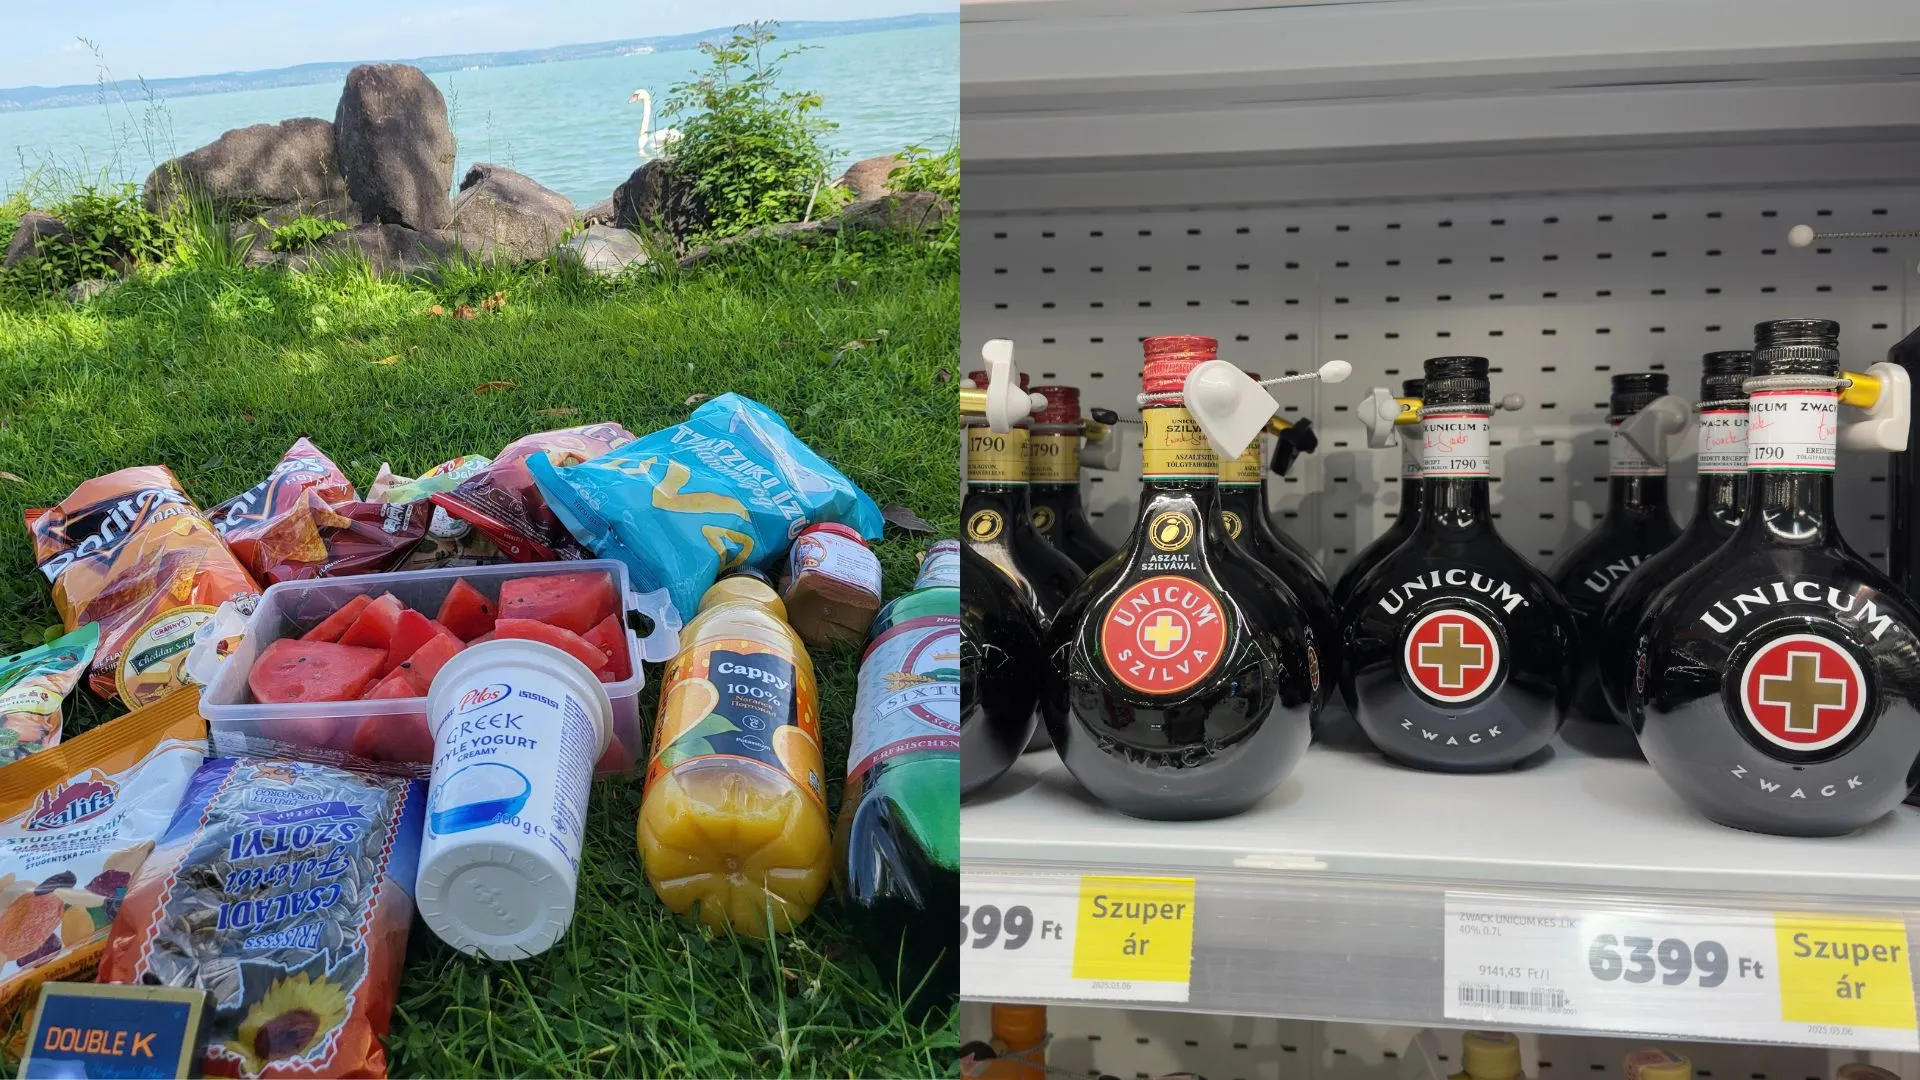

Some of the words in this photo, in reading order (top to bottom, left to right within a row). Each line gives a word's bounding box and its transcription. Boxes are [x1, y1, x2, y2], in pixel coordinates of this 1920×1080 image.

[1749, 402, 1787, 412] NICUM
[1429, 423, 1476, 431] UNICUM
[969, 437, 1005, 452] 1790
[1755, 446, 1784, 460] 1790
[1450, 459, 1476, 470] 1790
[39, 489, 189, 584] Doritos
[1141, 561, 1197, 570] SZILVÁVAL
[1149, 554, 1190, 562] ASZALT
[1584, 554, 1653, 594] UNI
[1378, 568, 1525, 615] UNICUM
[1113, 586, 1218, 627] UNICUM
[1700, 580, 1895, 641] UNICUM
[154, 619, 186, 636] GRANNY'S
[138, 647, 174, 667] Cheddar
[1118, 648, 1209, 682] SZILVA
[717, 662, 789, 690] Cappy
[459, 686, 501, 712] Pilos
[727, 683, 781, 707] 100%
[446, 713, 524, 745] GREEK
[1400, 718, 1503, 746] ZWACK
[434, 742, 468, 774] STYLE
[471, 734, 538, 751] YOGURT
[457, 746, 498, 763] CREAMY
[735, 736, 771, 751] Potassium
[1730, 764, 1863, 799] ZWACK
[27, 791, 115, 830] Kalifa
[7, 827, 90, 845] STUDENT
[228, 822, 361, 863] SZOTYI
[225, 845, 350, 894] Fehértói
[216, 884, 343, 933] CSALÁDI
[1092, 895, 1186, 925] Szuper
[1459, 911, 1495, 924] ZWACK
[1495, 914, 1536, 926] UNICUM
[1537, 916, 1557, 928] KES
[1041, 920, 1063, 940] Ft
[1458, 925, 1481, 936] 40%
[1122, 932, 1150, 956] ár
[1793, 932, 1901, 967] Szuper
[1479, 964, 1521, 979] 9141,43
[1588, 933, 1730, 988] 6399
[1738, 957, 1765, 980] Ft
[1835, 974, 1867, 1000] ár
[44, 1026, 128, 1056] DOUBLE
[131, 1032, 157, 1058] K
